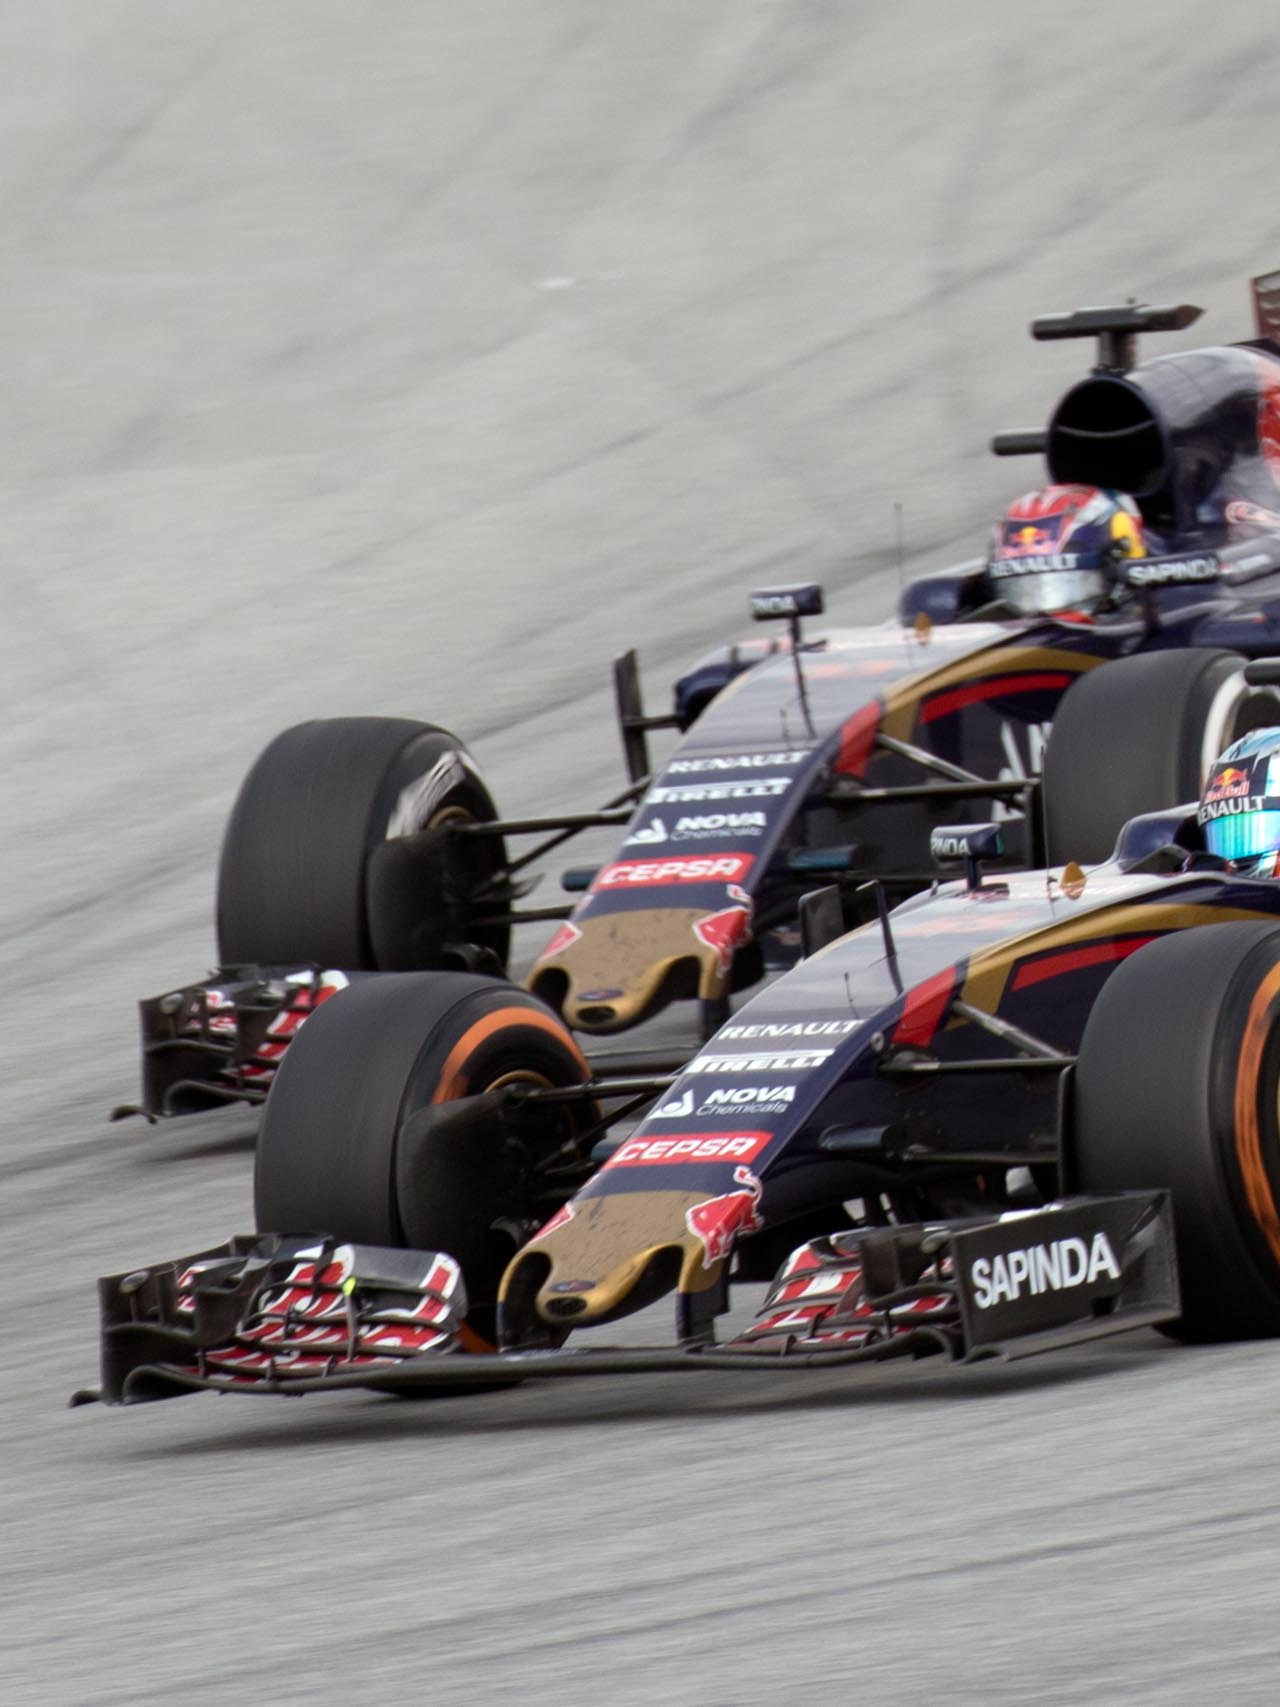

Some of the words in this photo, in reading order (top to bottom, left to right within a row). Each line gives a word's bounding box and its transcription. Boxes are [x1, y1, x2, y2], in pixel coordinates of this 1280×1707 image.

[668, 751, 812, 773] RENAULT
[645, 777, 793, 804] PIRELLI
[674, 811, 767, 832] NOVA
[600, 858, 744, 885] CEPSA
[718, 1019, 867, 1041] RENAULT
[686, 1049, 836, 1074] PIRELLI
[704, 1085, 798, 1105] NOVA
[695, 1102, 788, 1117] Chemicals
[613, 1136, 759, 1163] CEPSA
[971, 1232, 1121, 1310] SAPINDA
